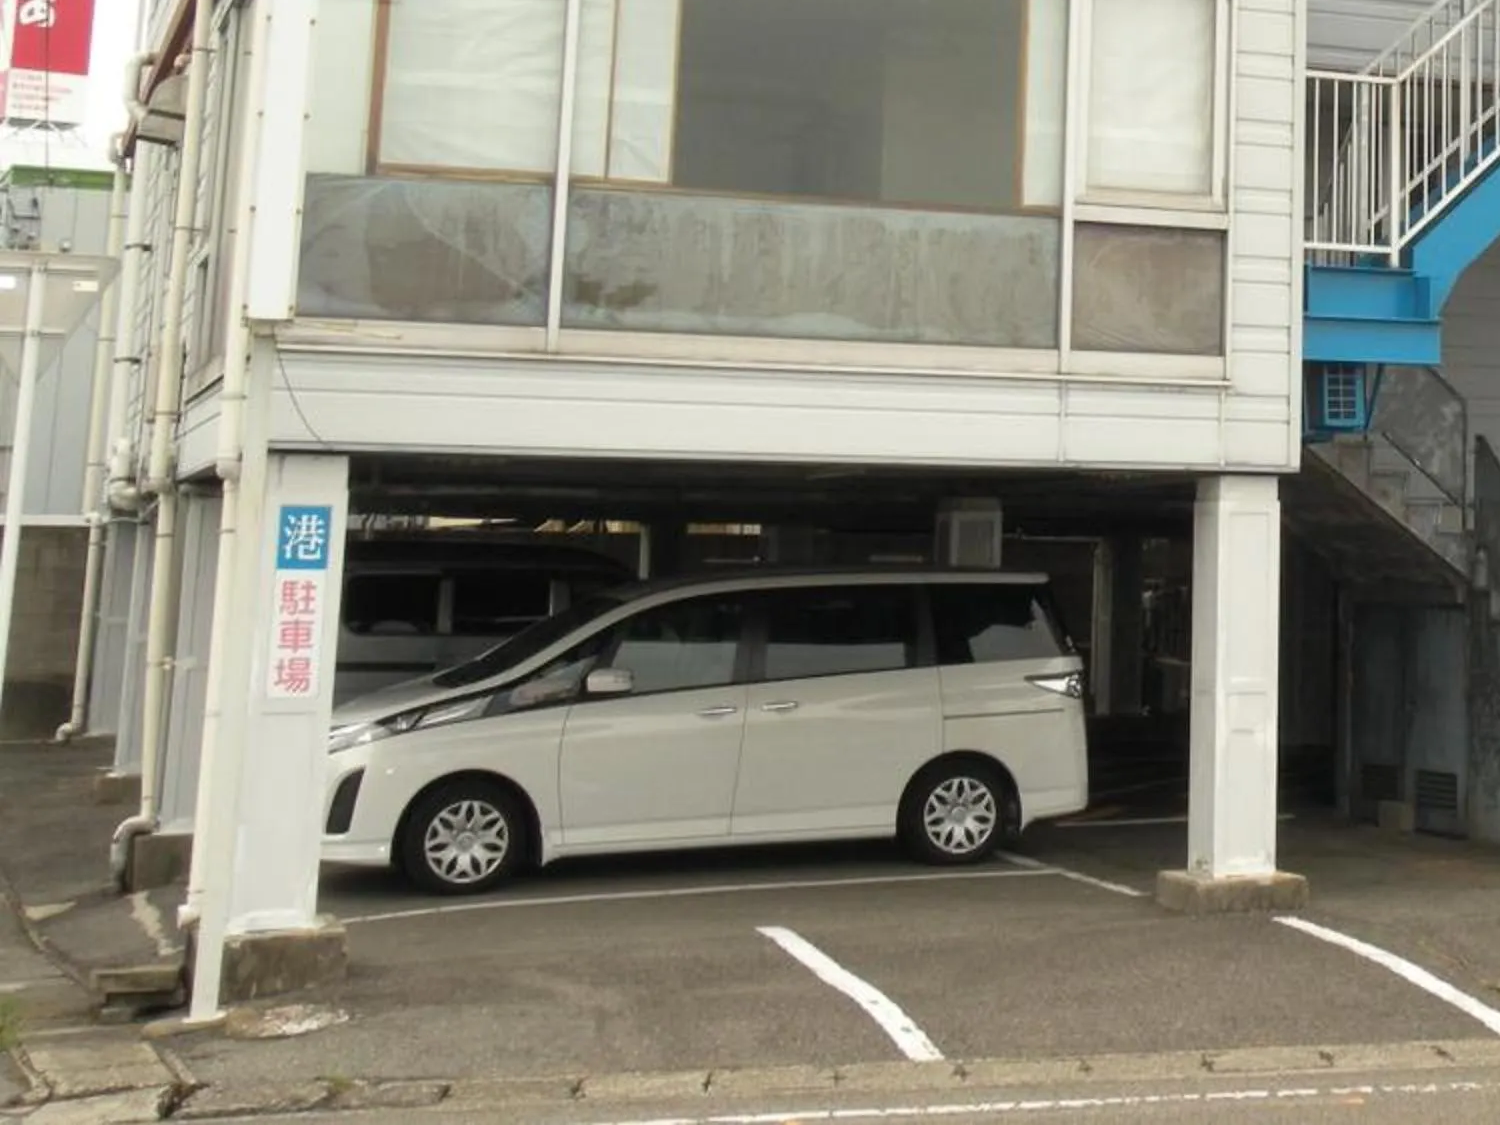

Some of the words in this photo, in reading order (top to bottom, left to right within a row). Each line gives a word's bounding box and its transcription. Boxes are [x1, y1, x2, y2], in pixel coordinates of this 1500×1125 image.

[283, 514, 326, 561] 港
[273, 580, 318, 694] 駐車場
